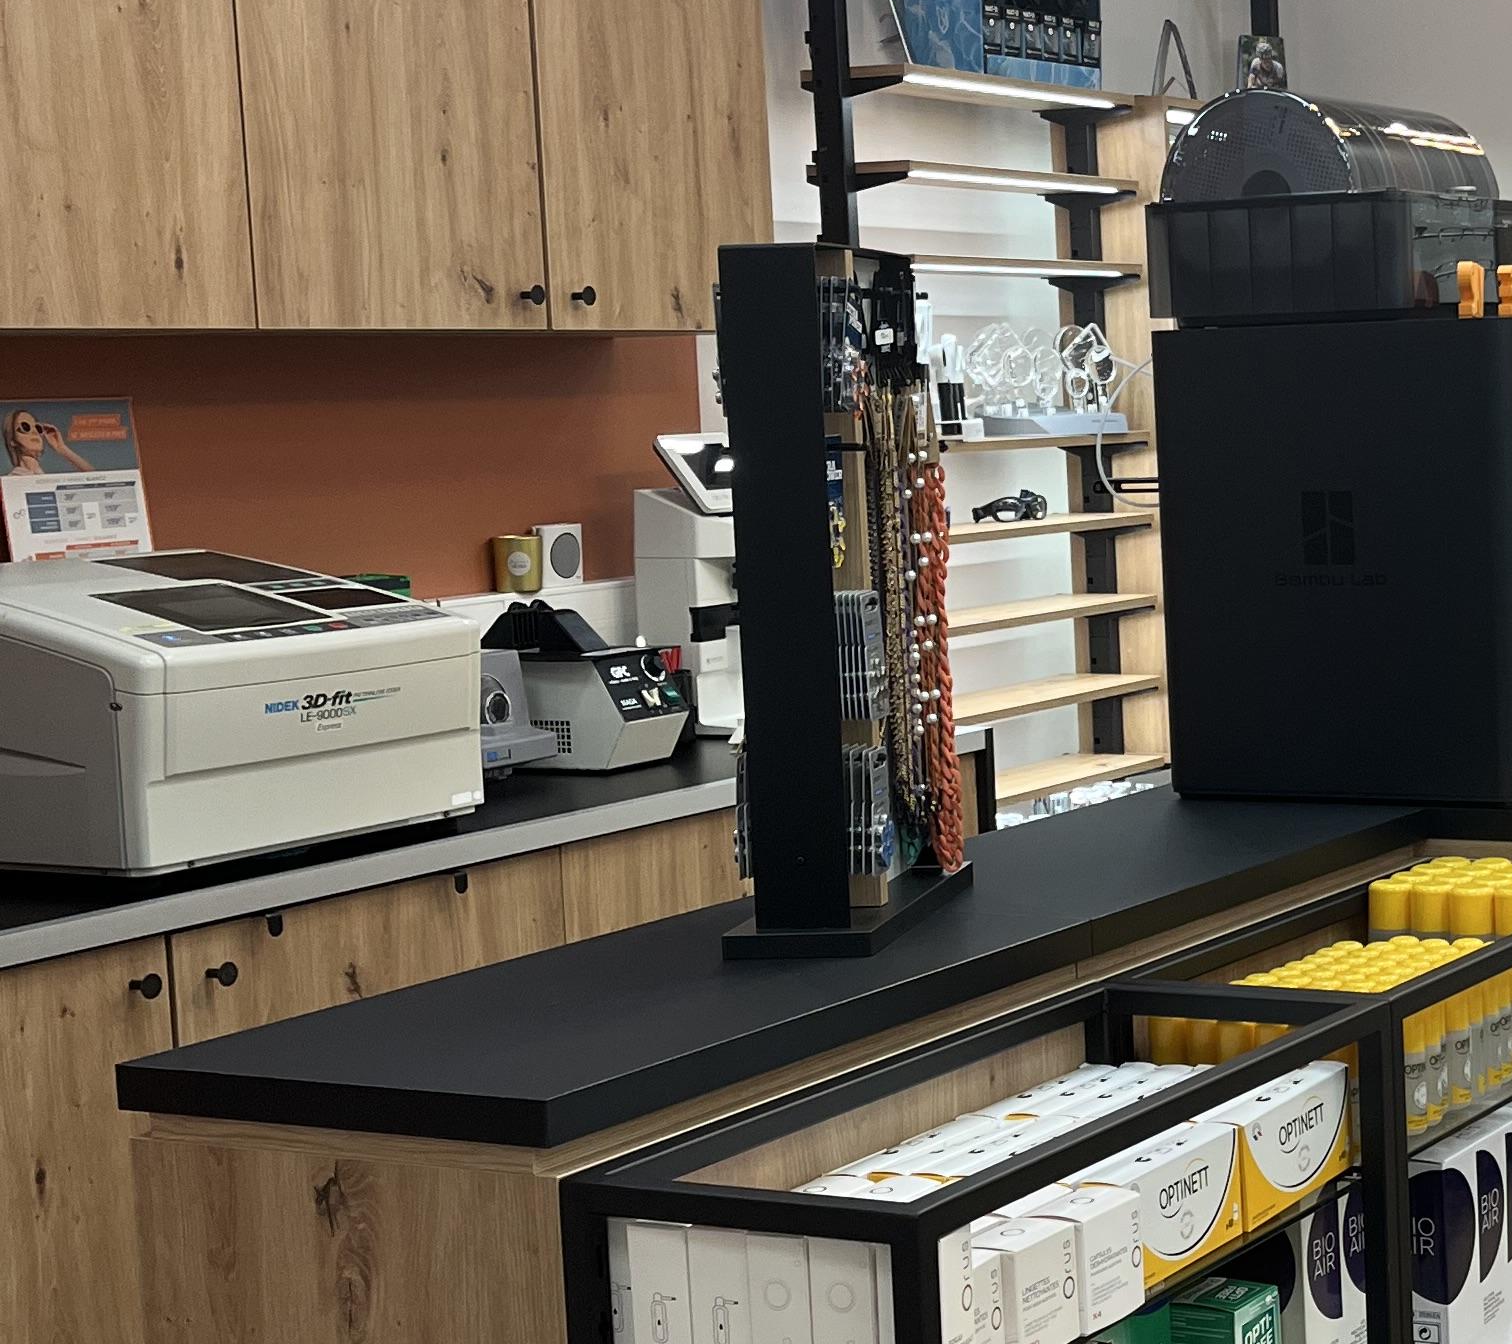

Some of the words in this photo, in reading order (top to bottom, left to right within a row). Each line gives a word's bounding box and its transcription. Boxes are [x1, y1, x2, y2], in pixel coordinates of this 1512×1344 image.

[264, 699, 300, 714] NIDEK
[301, 690, 353, 711] 3D-fit
[1279, 1103, 1325, 1146] OPTINETT
[1159, 1165, 1210, 1211] OPTINETT
[1481, 1188, 1500, 1215] BIO
[1412, 1217, 1436, 1234] IO
[1482, 1211, 1500, 1233] AIR
[1312, 1232, 1336, 1260] BIO
[1412, 1237, 1436, 1256] IR
[1314, 1253, 1336, 1281] AIR
